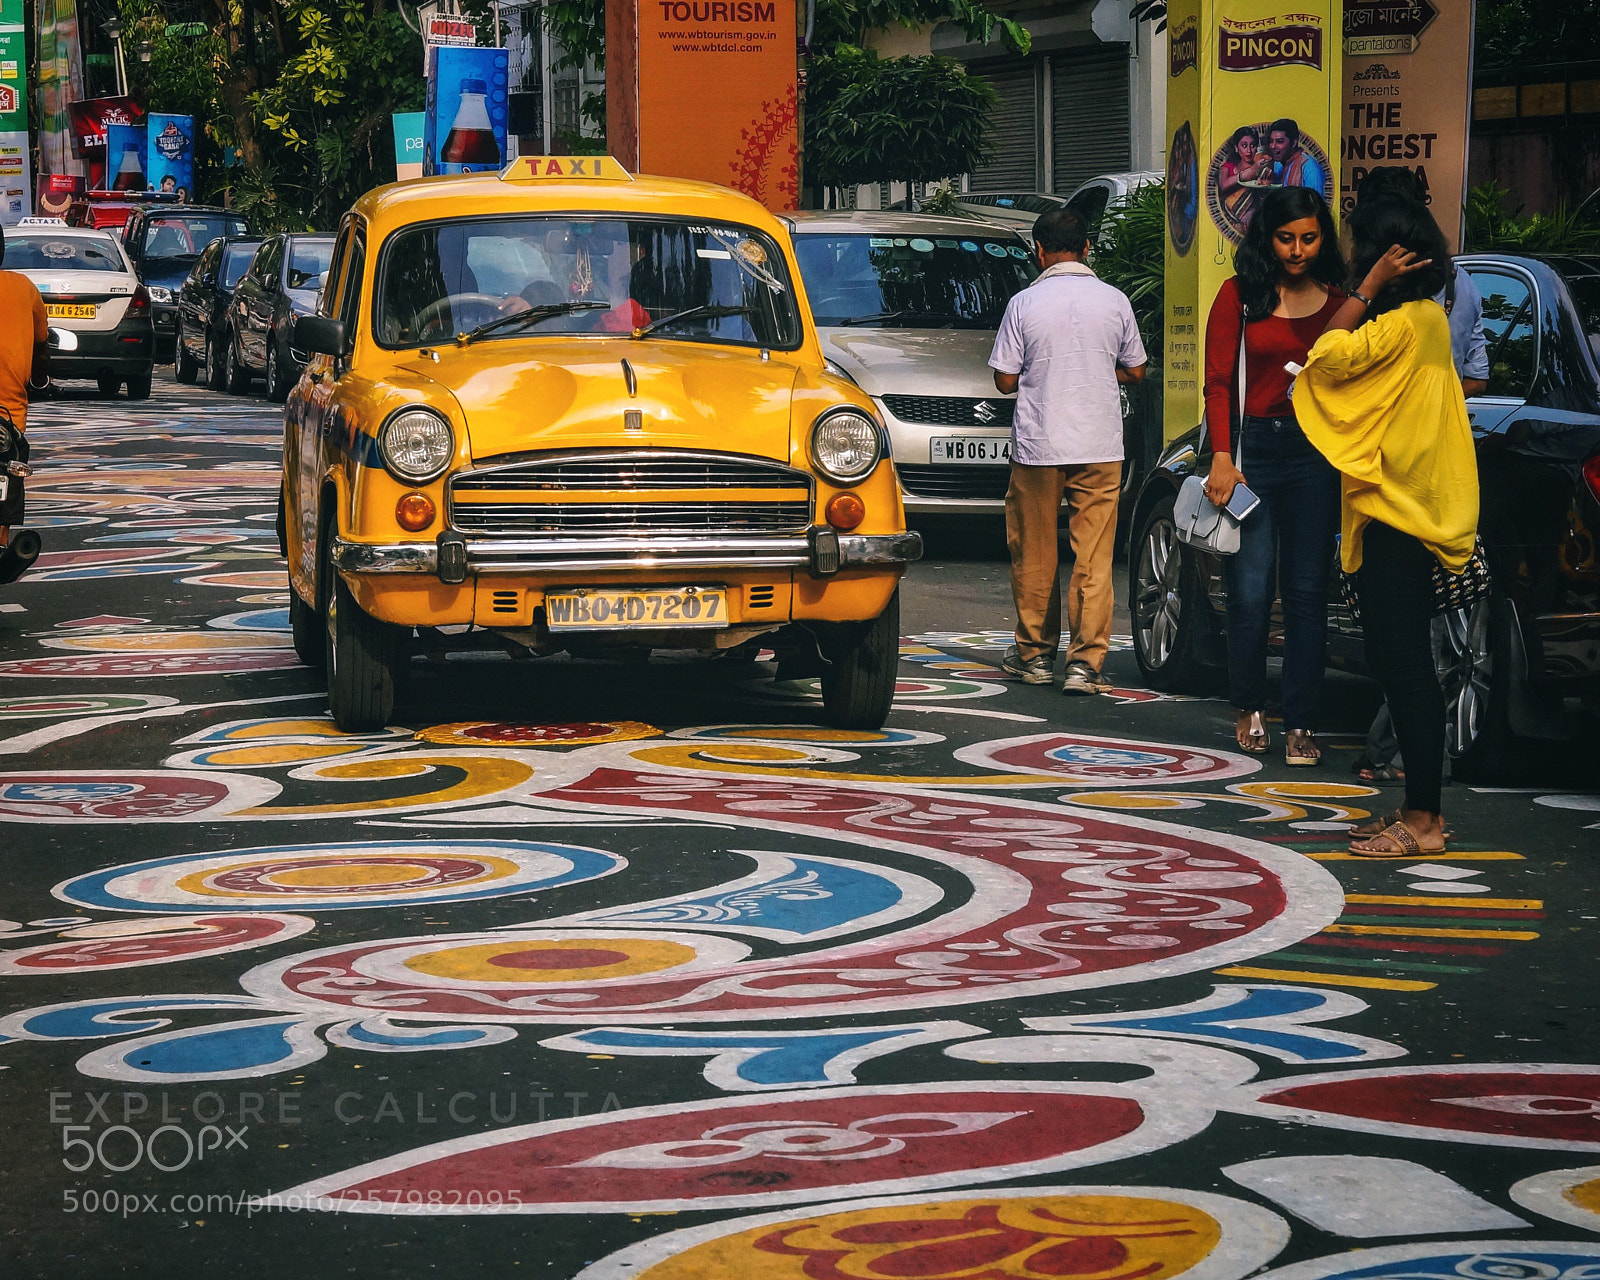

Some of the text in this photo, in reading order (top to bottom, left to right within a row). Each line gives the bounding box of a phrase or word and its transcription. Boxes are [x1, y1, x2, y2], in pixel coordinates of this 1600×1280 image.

[659, 1, 776, 23] TOURISM
[430, 20, 474, 38] KIDZEE
[658, 30, 777, 41] www.wbtourism.gov.in
[672, 43, 763, 52] www.wbtdcl.com
[1226, 38, 1313, 58] PINCON
[1349, 37, 1412, 54] pantaloons
[1353, 84, 1400, 97] Presents
[101, 116, 129, 125] MAGIC
[1349, 102, 1402, 129] THE
[405, 137, 424, 152] pa
[525, 159, 602, 176] TAXI
